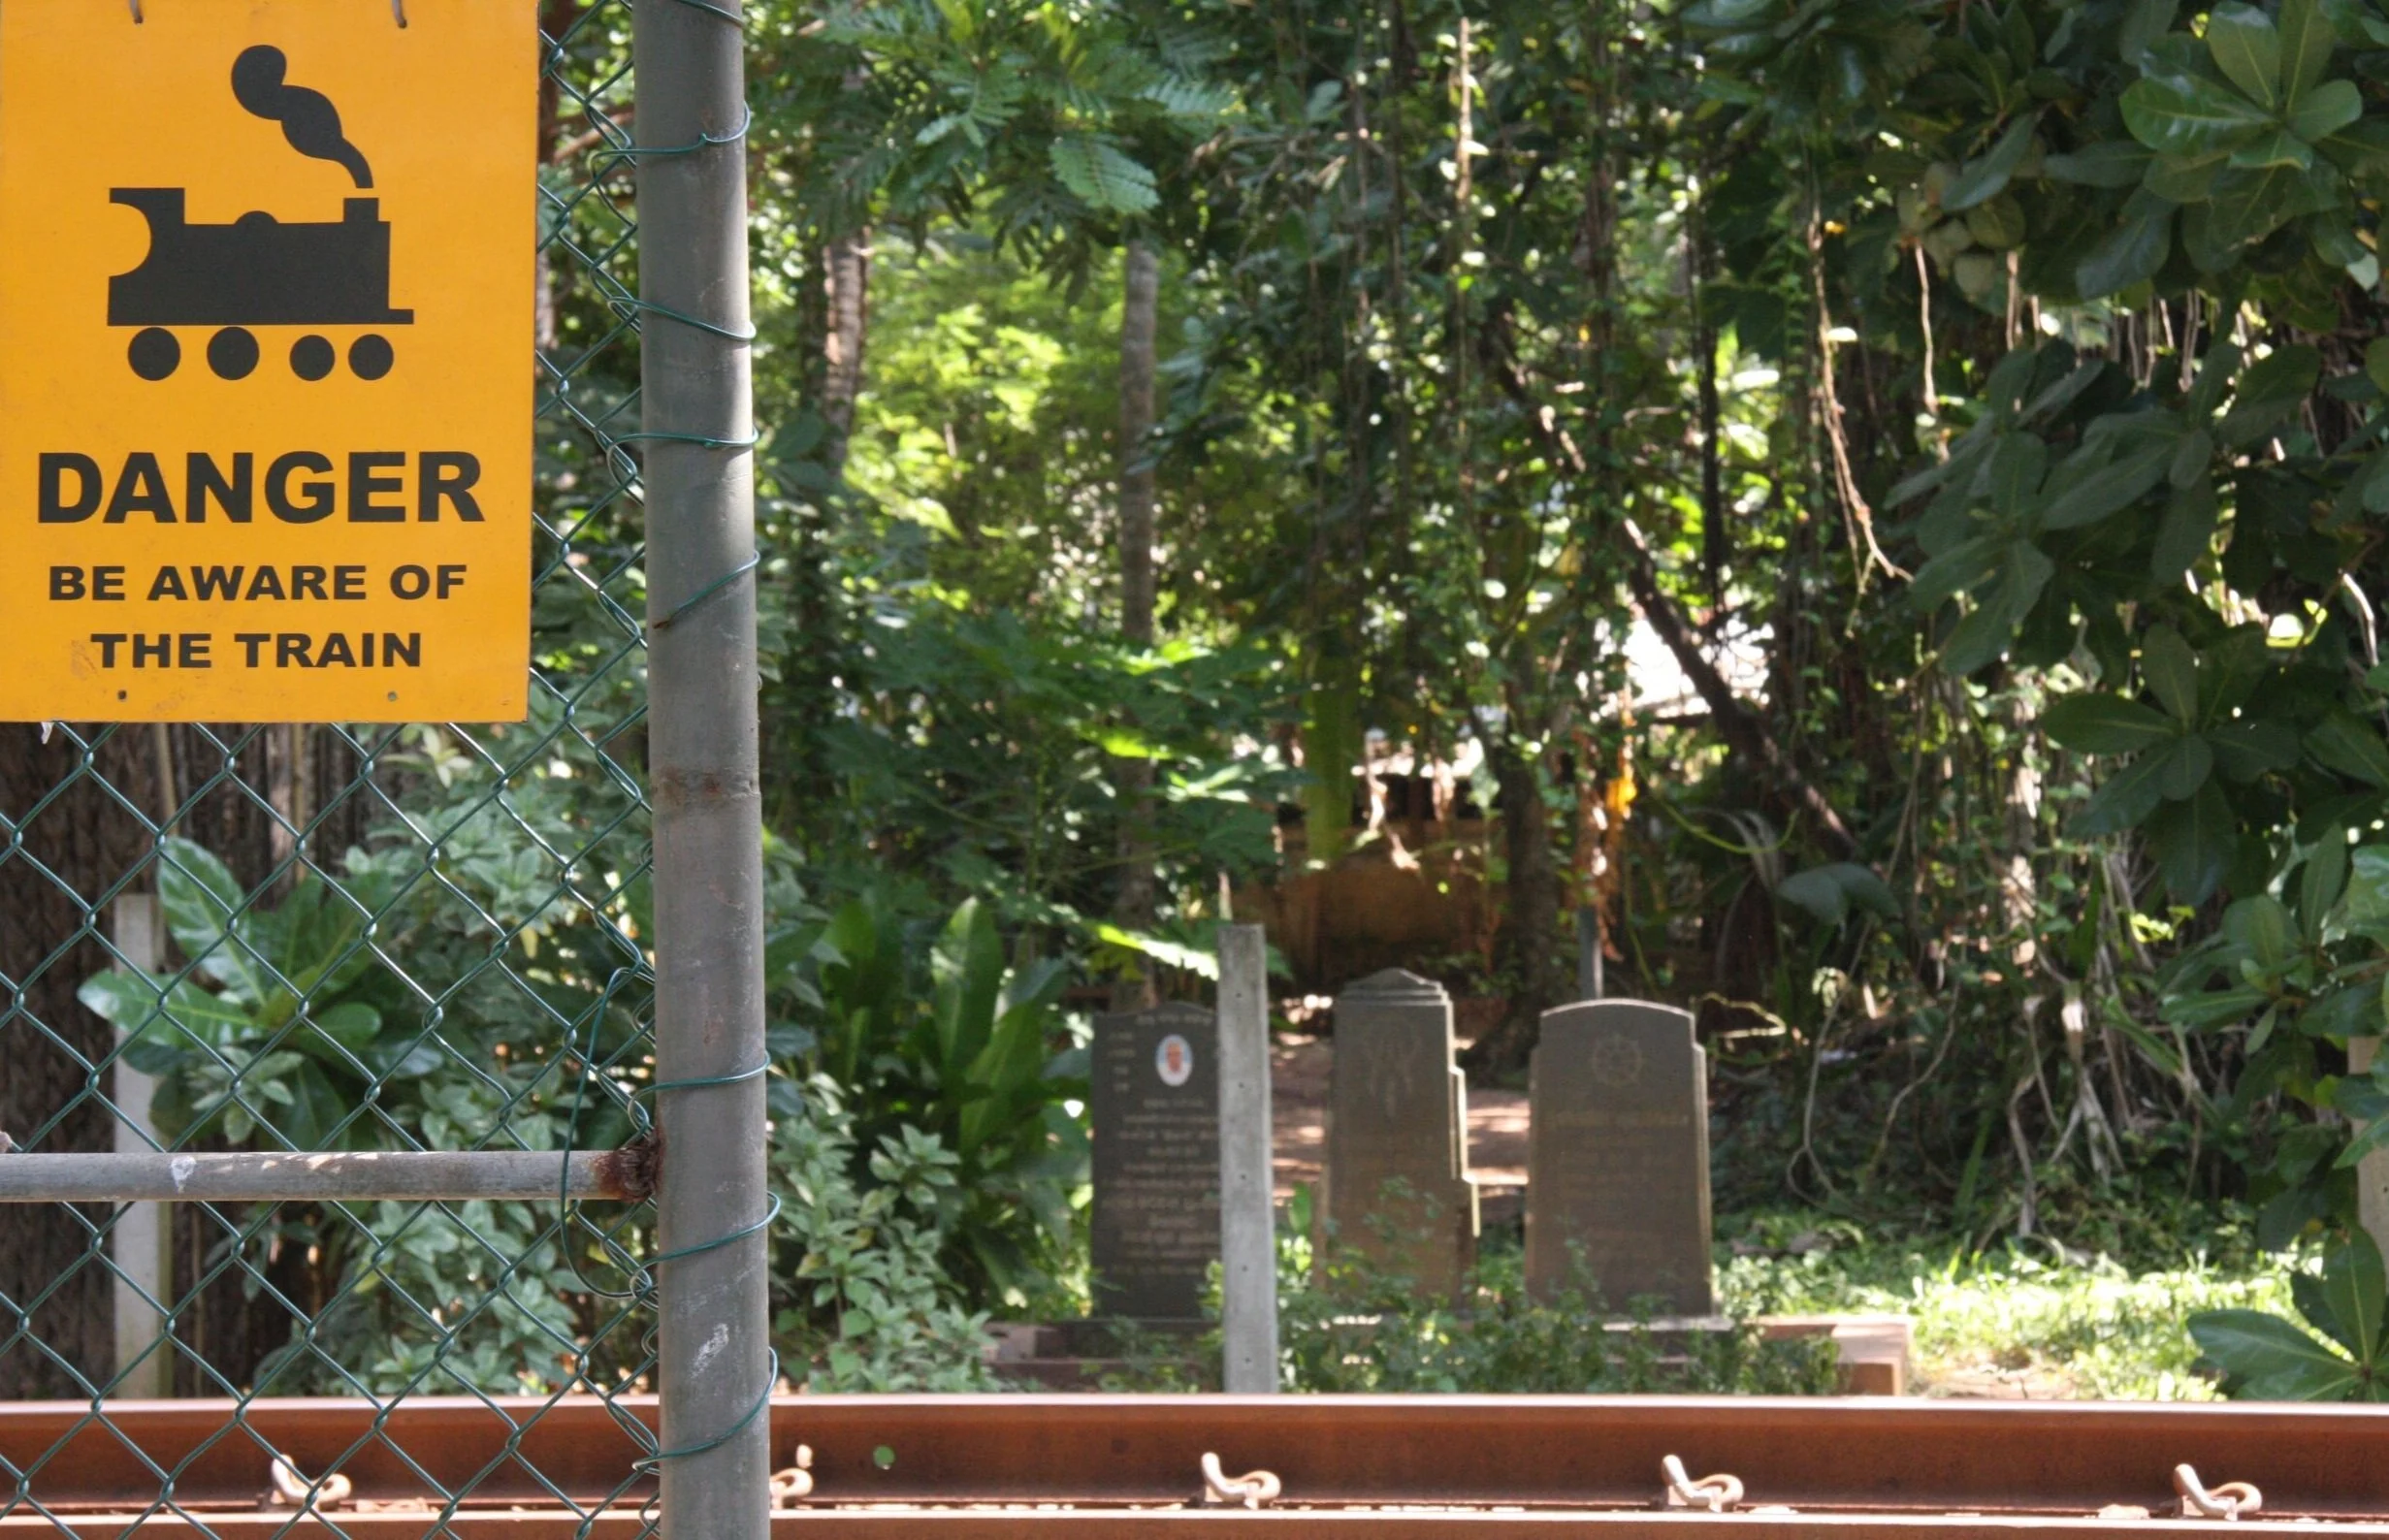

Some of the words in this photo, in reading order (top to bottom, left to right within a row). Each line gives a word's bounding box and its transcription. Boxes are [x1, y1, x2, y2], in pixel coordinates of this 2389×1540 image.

[38, 450, 485, 525] DANGER
[48, 565, 126, 601] BE
[146, 565, 367, 601] AWARE
[390, 564, 467, 599] OF
[90, 633, 212, 669] THE
[234, 632, 421, 668] TRAIN
